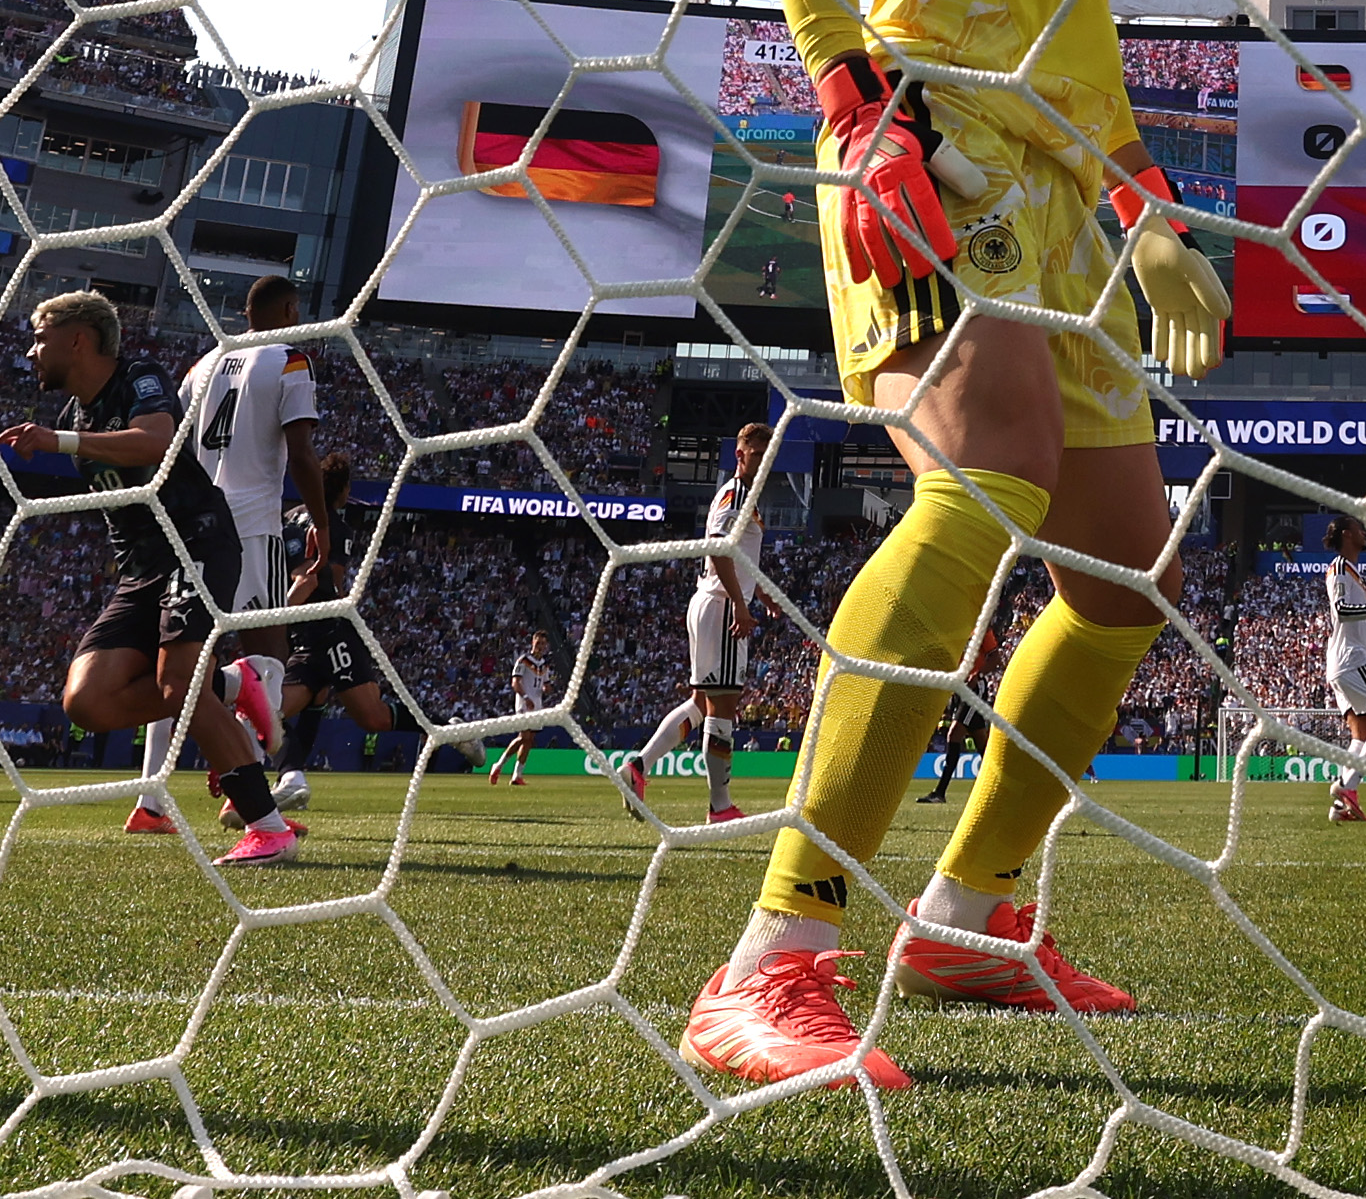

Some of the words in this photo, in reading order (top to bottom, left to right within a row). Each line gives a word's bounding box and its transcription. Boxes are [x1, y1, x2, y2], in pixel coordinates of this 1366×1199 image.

[755, 44, 804, 62] 41:2
[735, 128, 796, 141] aramco
[1301, 213, 1346, 251] 0
[221, 356, 247, 376] TAH
[201, 388, 238, 451] 4
[1159, 418, 1223, 444] FIFA
[1227, 419, 1334, 444] WORLD
[461, 495, 504, 514] FIFA
[508, 497, 582, 518] WORLD
[584, 501, 624, 520] CUP
[627, 503, 665, 522] 20
[1302, 562, 1329, 574] WOR
[327, 641, 352, 675] 16
